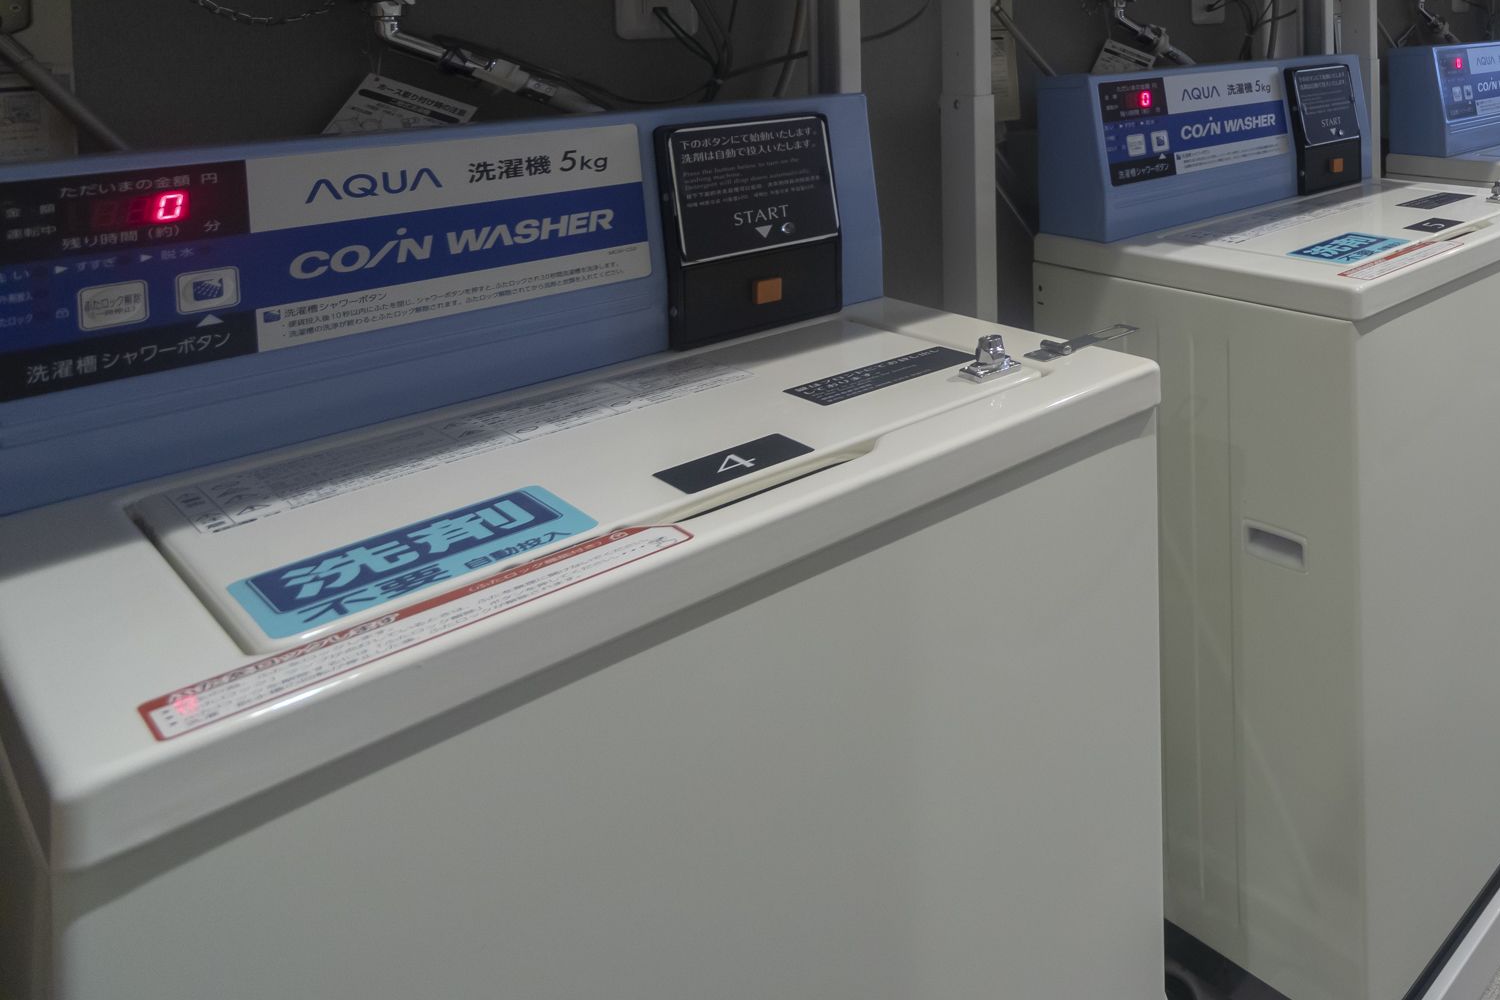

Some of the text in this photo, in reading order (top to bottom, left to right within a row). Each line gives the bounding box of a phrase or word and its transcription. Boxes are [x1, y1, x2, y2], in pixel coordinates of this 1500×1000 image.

[1141, 91, 1151, 107] 0
[1181, 84, 1220, 102] AQUA
[1227, 79, 1271, 96] 洗濯機 5kg
[1223, 112, 1276, 133] WASHER
[1321, 116, 1342, 128] START
[680, 127, 818, 151] 下のボタンにて始動いたします。
[681, 139, 817, 164] 洗剤は自動で投入いたします。
[468, 149, 608, 184] 洗濯機 5kg
[60, 172, 218, 199] ただいまの金額 円
[305, 167, 443, 204] AQUA
[157, 193, 184, 220] 0
[733, 204, 789, 226] START
[203, 219, 222, 233] 分
[447, 208, 615, 255] WASHER
[1303, 233, 1377, 257] 洗剤
[75, 257, 118, 271] すすぎ
[284, 291, 388, 318] 洗濯槽シャワーボタン
[27, 332, 232, 385] 洗濯槽シャワーボタン
[717, 454, 756, 473] 4
[284, 498, 540, 600] 洗剤
[297, 531, 573, 624] 不要 自動投入
